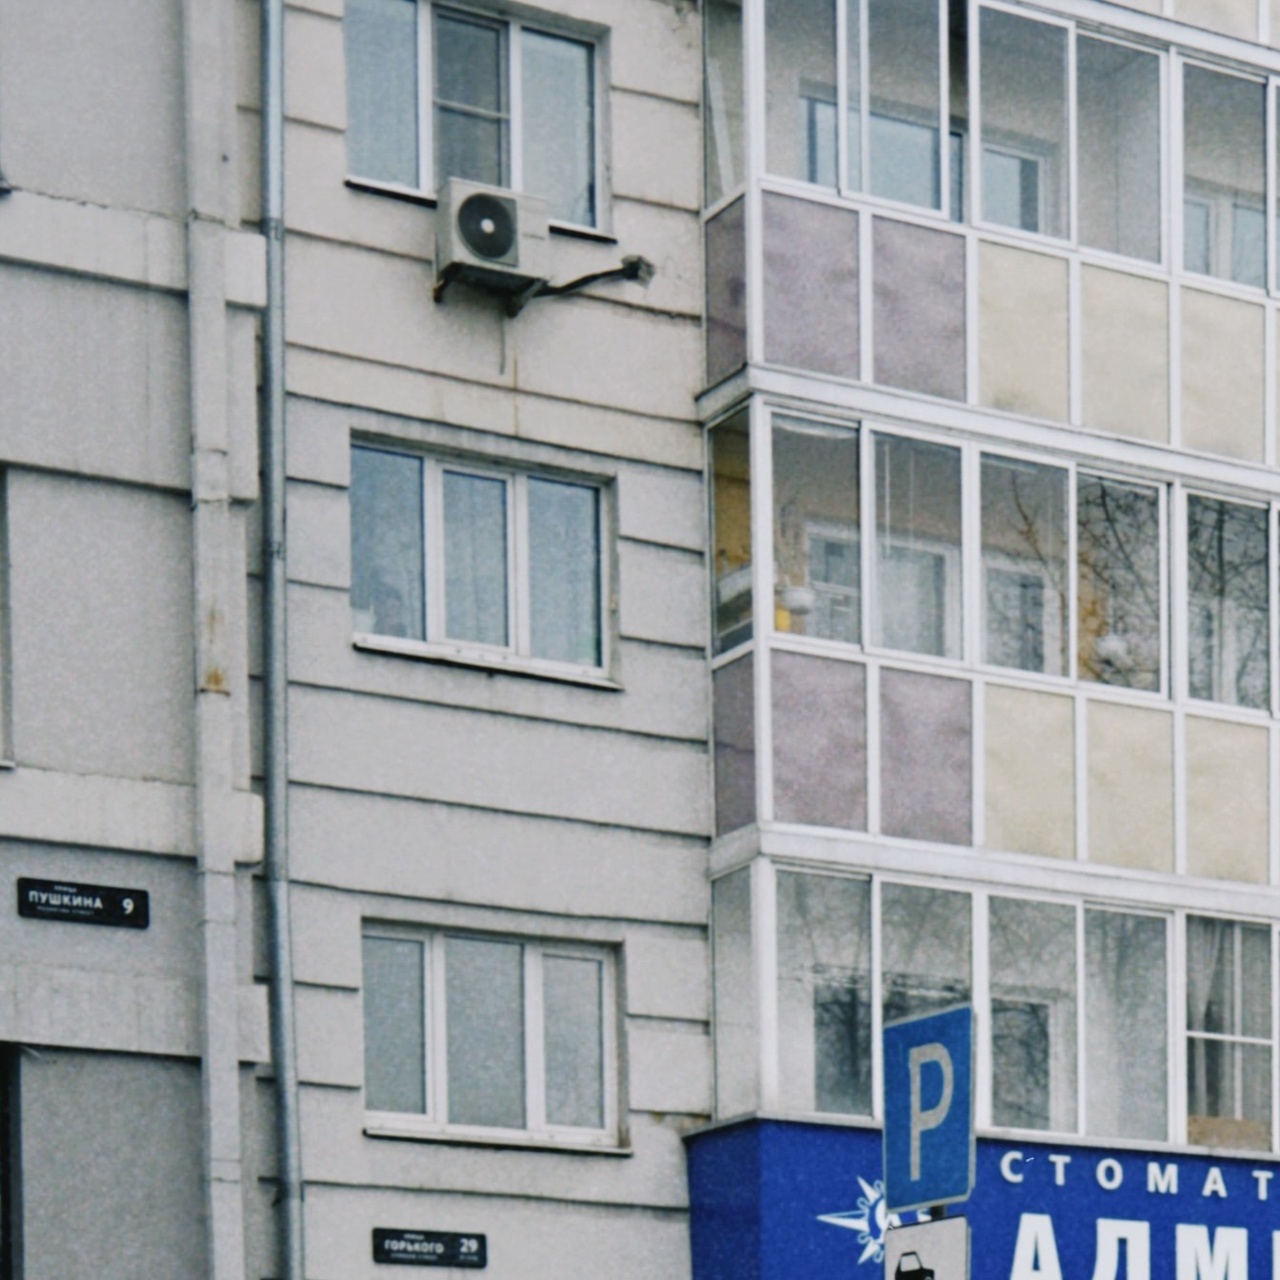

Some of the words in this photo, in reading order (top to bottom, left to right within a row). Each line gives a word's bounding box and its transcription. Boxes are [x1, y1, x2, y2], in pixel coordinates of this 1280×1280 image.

[28, 890, 103, 909] ПУШКИНА
[122, 897, 135, 915] 9
[909, 1042, 953, 1182] P
[384, 1239, 445, 1254] ГОРЬКОГО
[460, 1238, 479, 1254] 29
